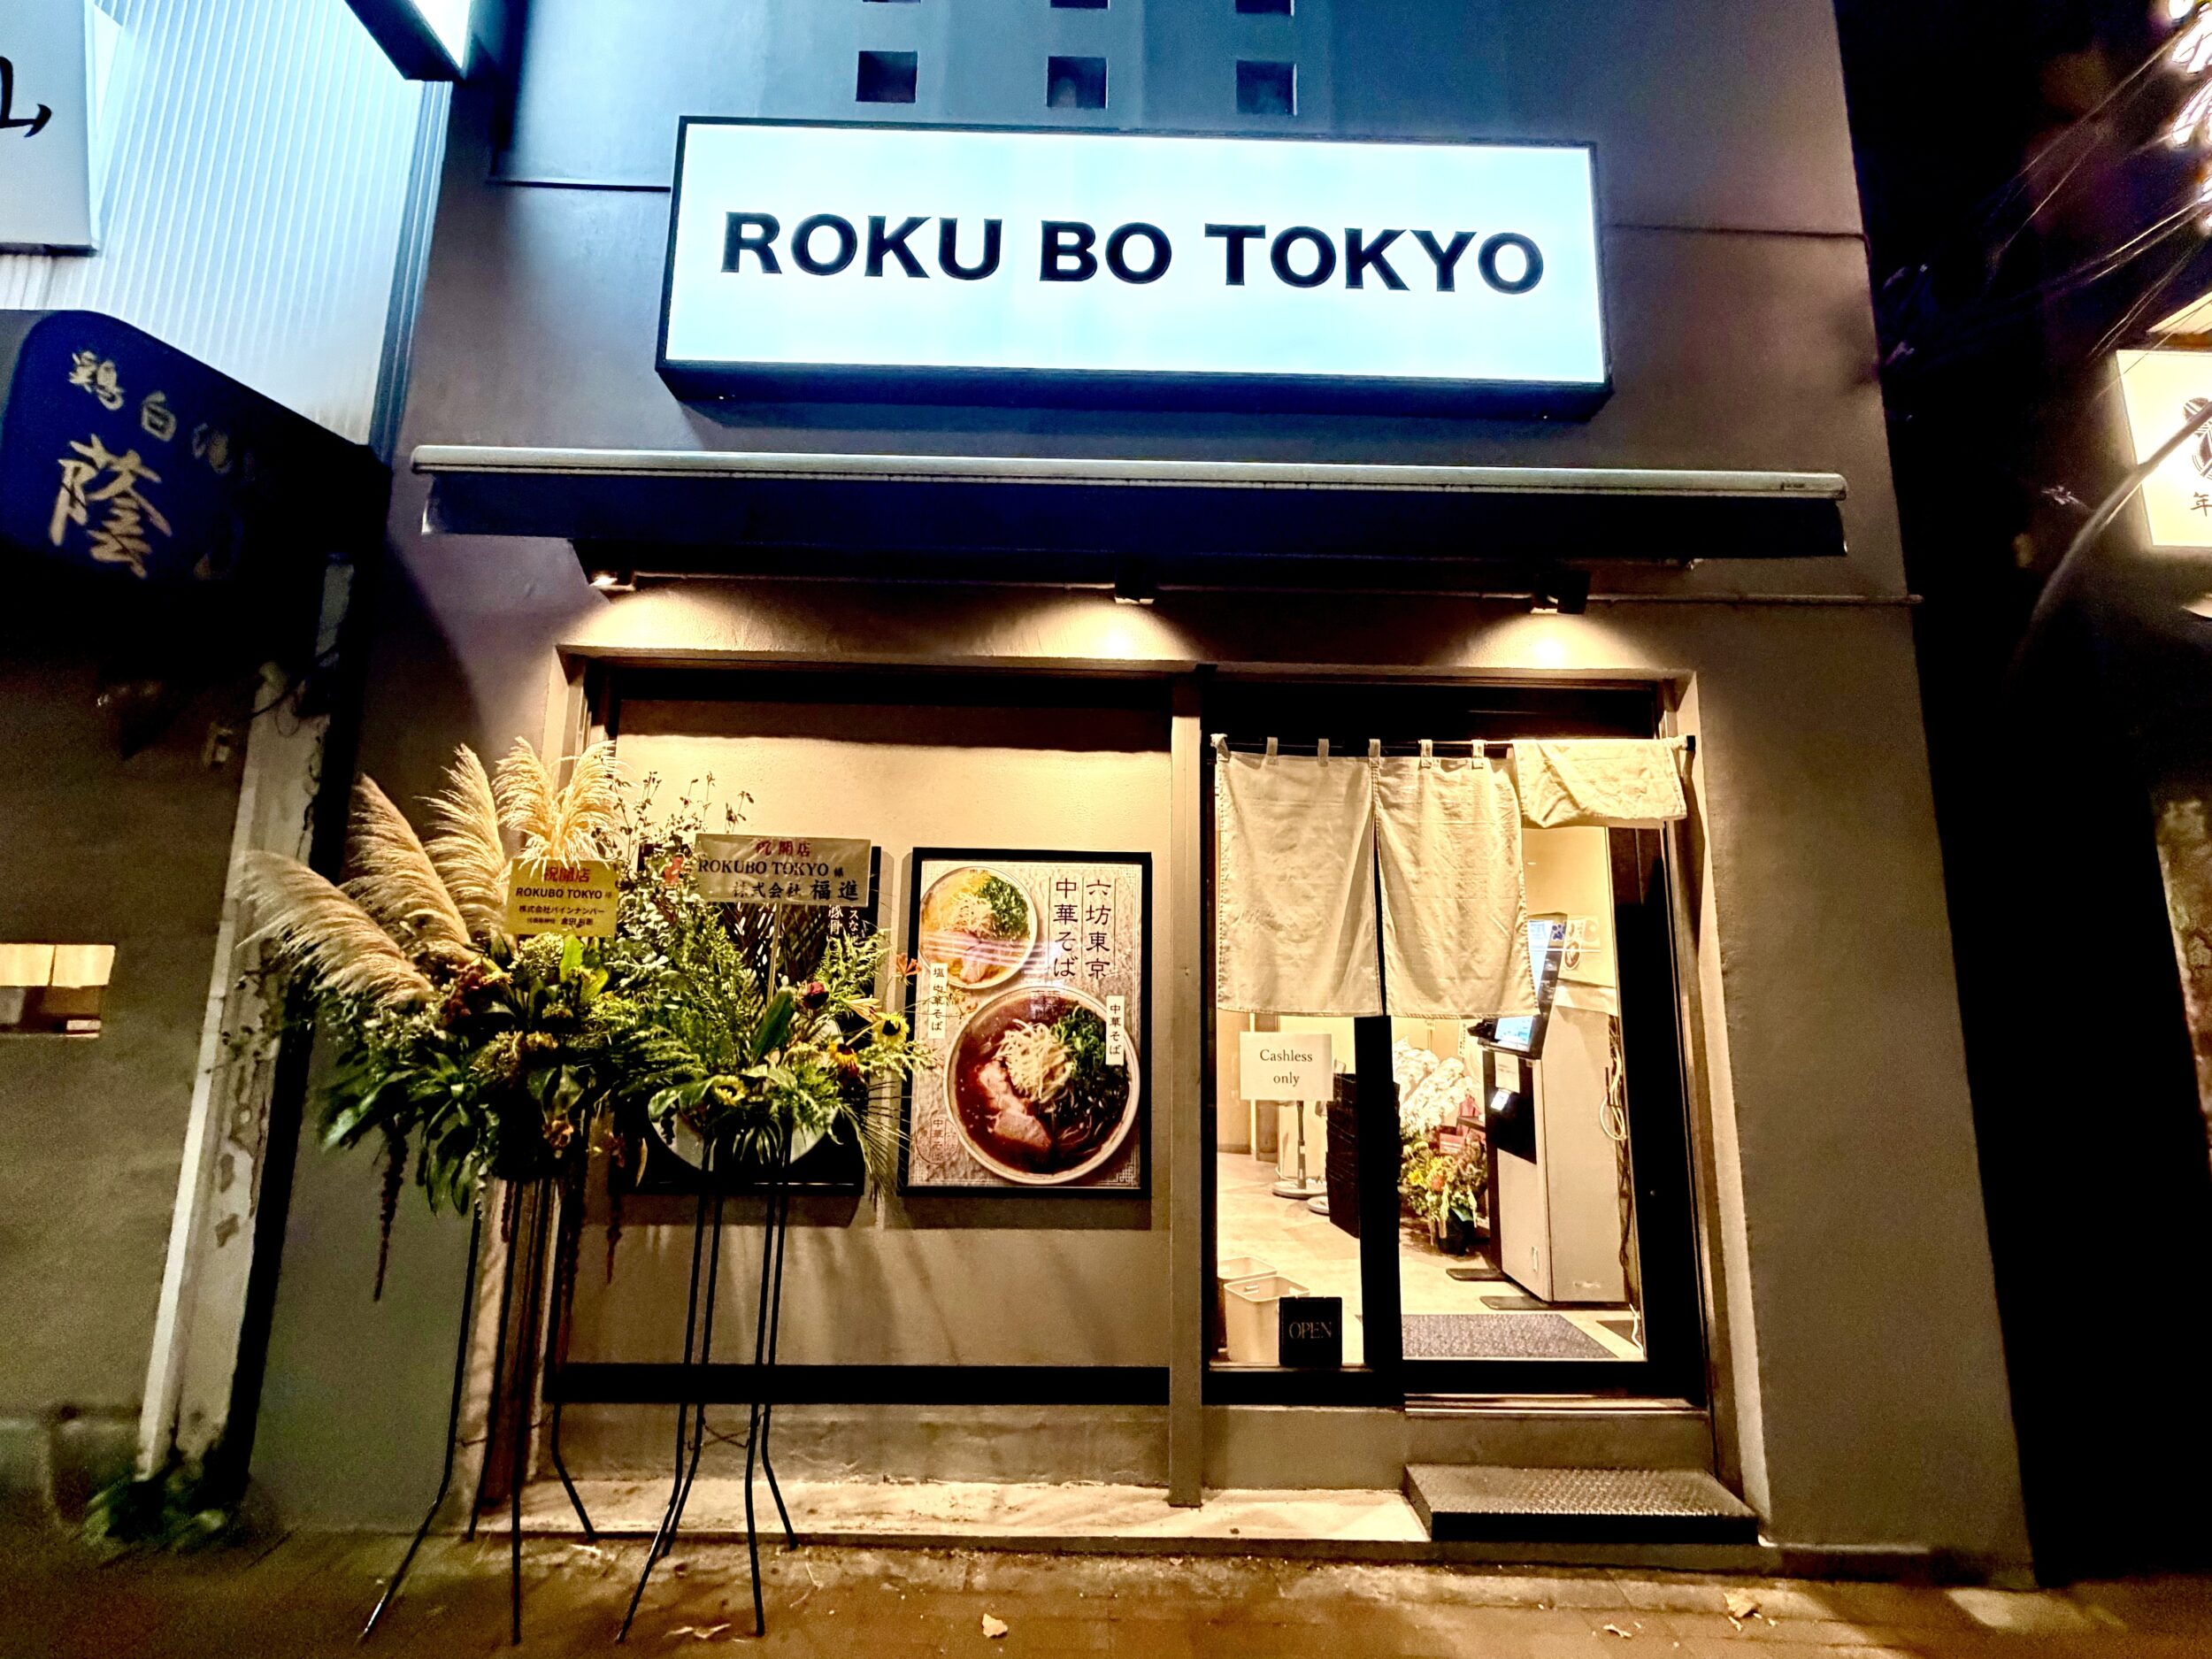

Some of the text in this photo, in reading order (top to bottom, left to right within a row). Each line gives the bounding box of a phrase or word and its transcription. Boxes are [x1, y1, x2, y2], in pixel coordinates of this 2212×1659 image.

[724, 214, 1541, 293] ROKU BO TOKYO
[756, 841, 812, 857] 祝開店
[544, 866, 591, 883] 祝開店
[698, 859, 767, 874] ROKUBO
[772, 862, 829, 877] TOKYO
[516, 887, 564, 898] ROKUBO
[567, 888, 603, 899] TOKYO
[810, 879, 859, 901] 福進
[1053, 878, 1079, 978] 中華そば
[1085, 879, 1112, 979] 六坊東京
[932, 967, 945, 1031] 塩中華そば
[1110, 1003, 1121, 1056] 中華そば
[1259, 1048, 1314, 1063] Cashless
[1272, 1071, 1301, 1087] only
[1288, 1321, 1333, 1340] OPEN
